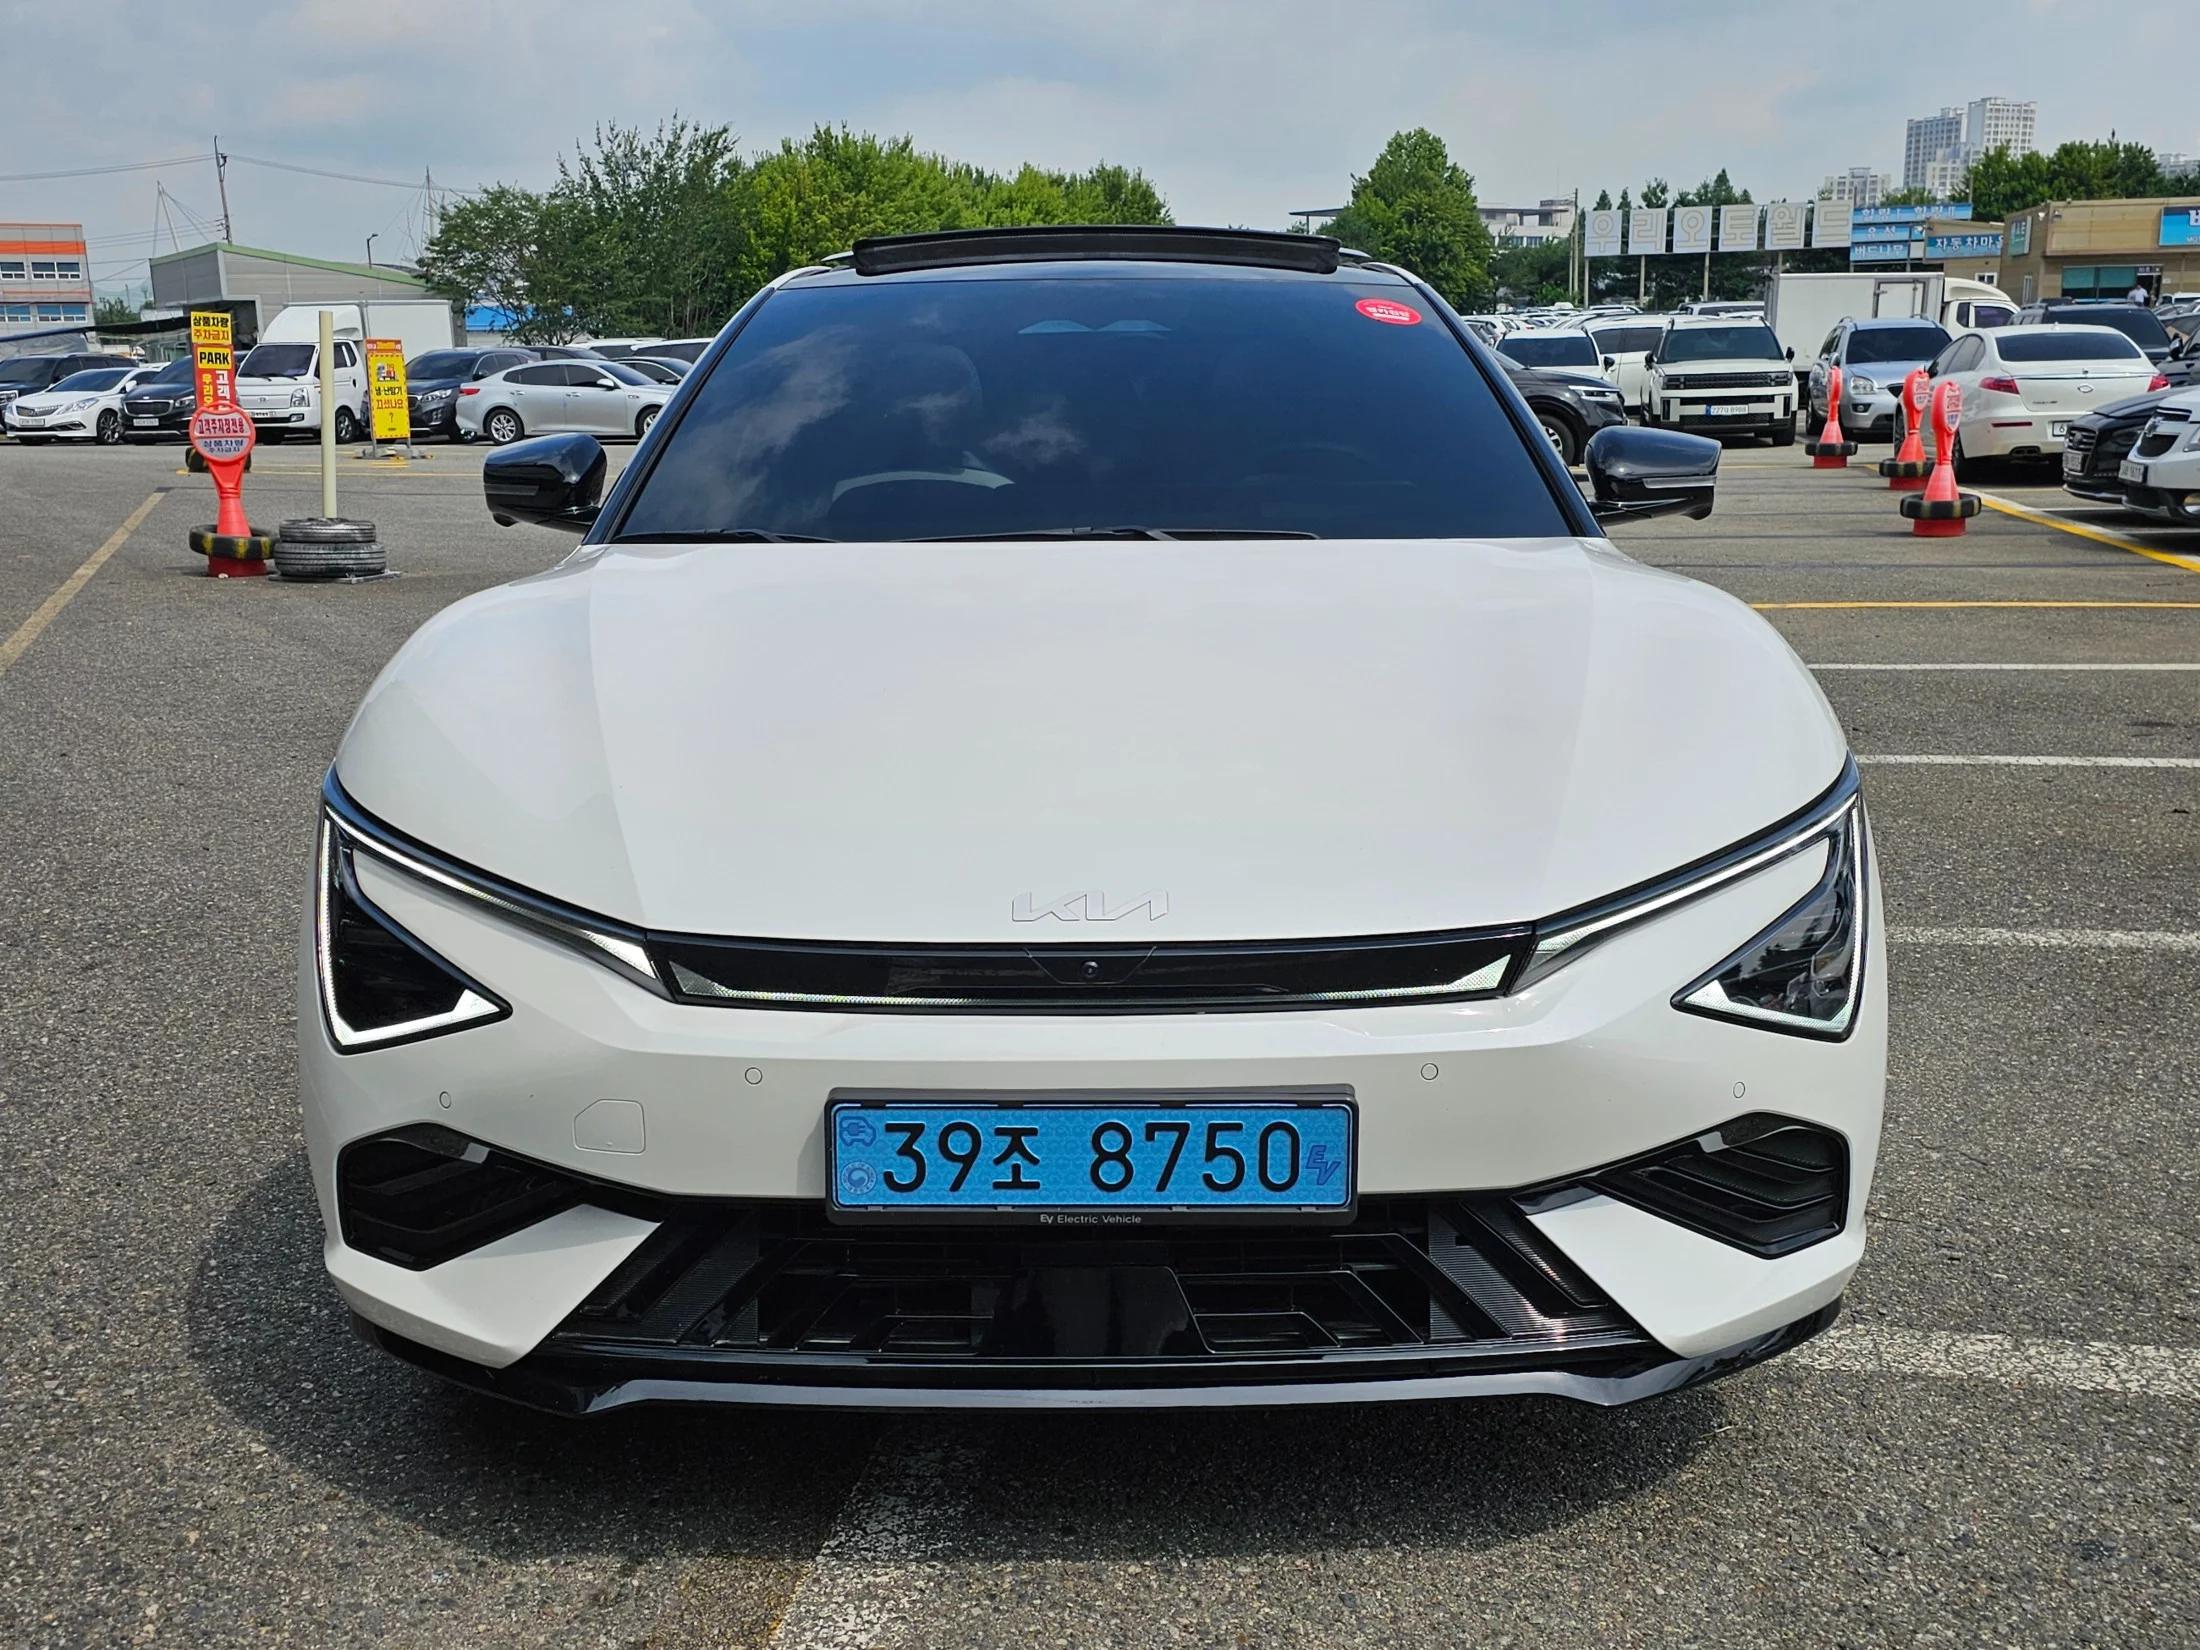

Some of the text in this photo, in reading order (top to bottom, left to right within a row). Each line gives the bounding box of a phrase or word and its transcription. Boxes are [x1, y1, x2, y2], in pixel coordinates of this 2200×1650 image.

[1587, 202, 1850, 254] 우리오토월드
[193, 329, 229, 341] 주차금지
[200, 351, 230, 364] PARK
[1012, 889, 1168, 921] KIA
[882, 1121, 1301, 1193] 39조 8750
[1305, 1144, 1341, 1186] EV
[1057, 1214, 1099, 1224] Electric
[1102, 1214, 1142, 1224] Vehicle
